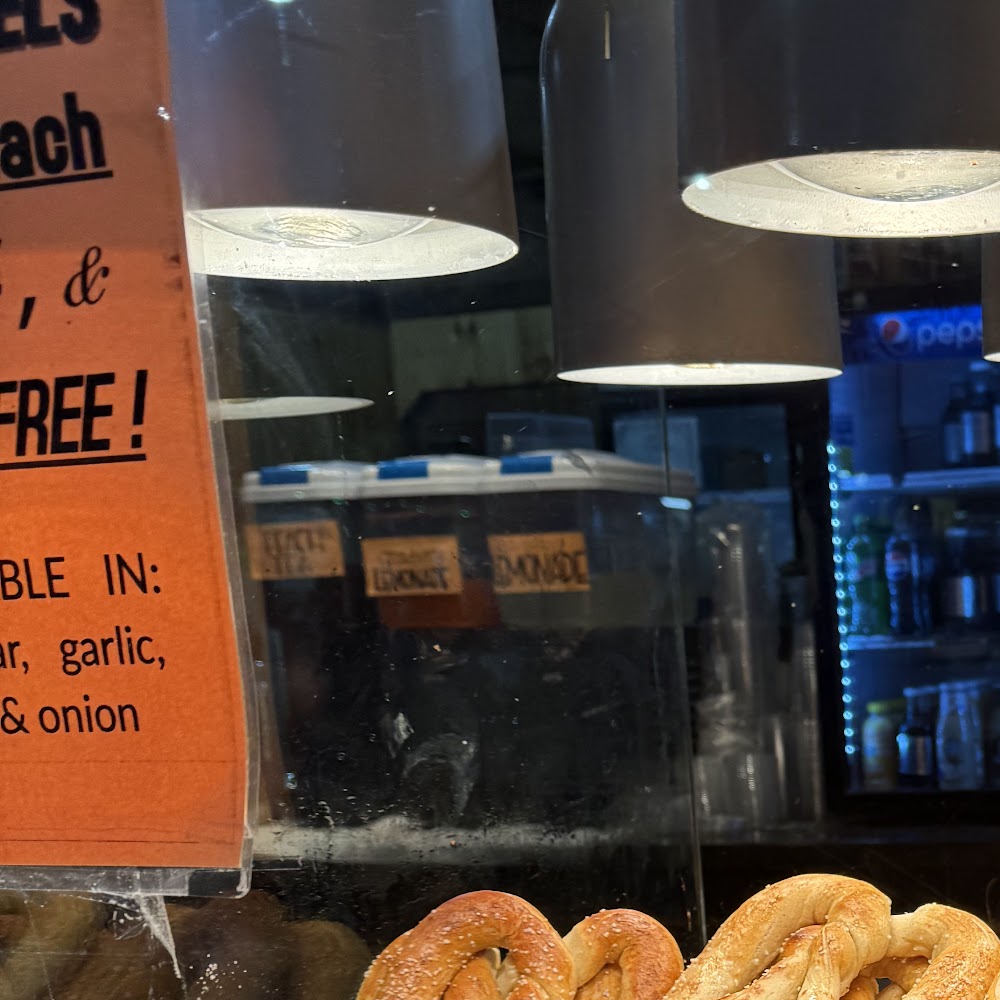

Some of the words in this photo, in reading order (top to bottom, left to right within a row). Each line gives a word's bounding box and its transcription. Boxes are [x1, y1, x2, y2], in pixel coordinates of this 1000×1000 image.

[103, 552, 161, 596] IN:
[60, 625, 166, 676] garlic,
[0, 696, 30, 735] &
[38, 694, 140, 734] onion
